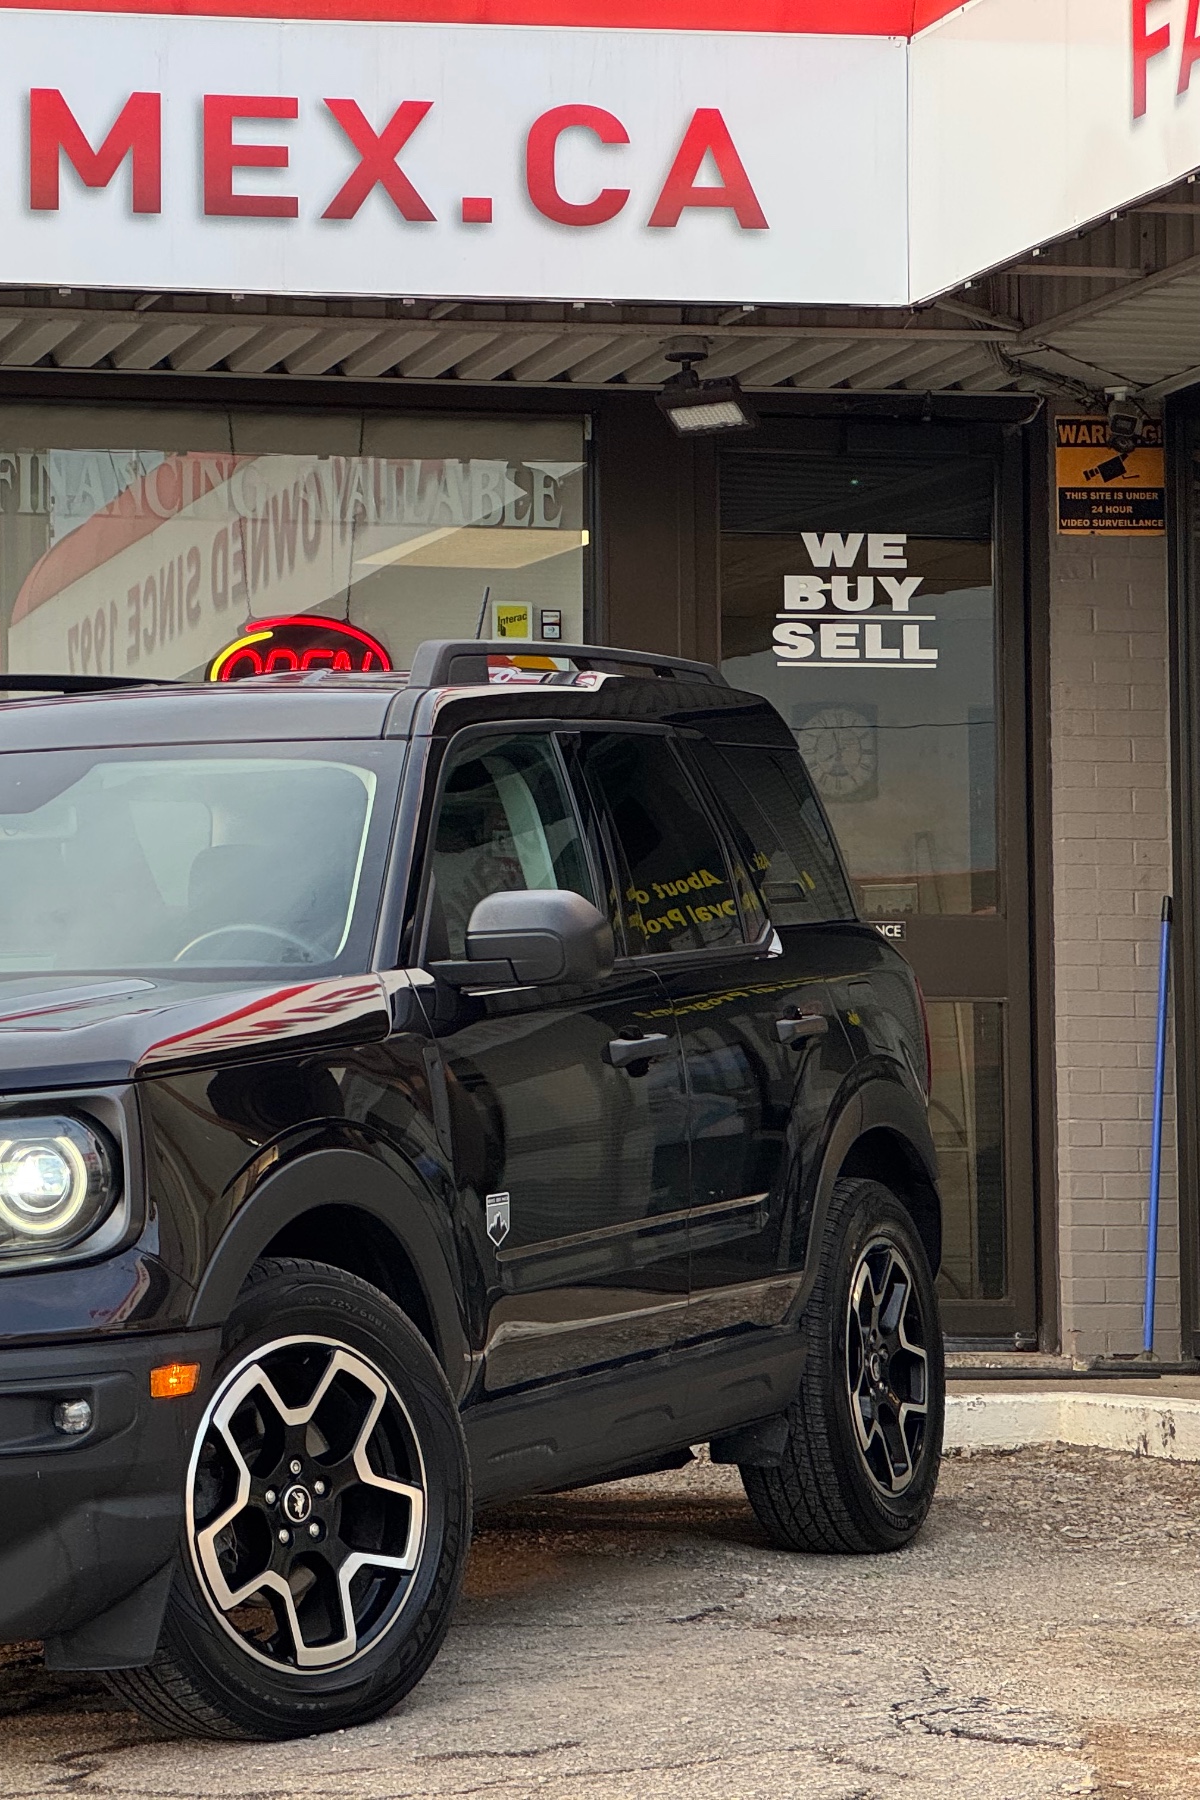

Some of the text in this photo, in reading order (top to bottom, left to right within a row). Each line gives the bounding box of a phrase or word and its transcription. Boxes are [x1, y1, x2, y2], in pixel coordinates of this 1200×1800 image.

[1058, 424, 1161, 444] WARG!
[298, 454, 564, 529] AVAILABLE
[1065, 491, 1159, 500] THIS SITE IS UNDER
[1091, 505, 1133, 514] 24 HOUR
[1061, 519, 1164, 527] VIDEO SURVEILLANCE
[800, 532, 907, 569] WE
[784, 574, 924, 612] BUY
[498, 613, 528, 627] Interac
[772, 622, 938, 659] SELL
[874, 924, 902, 938] NCE
